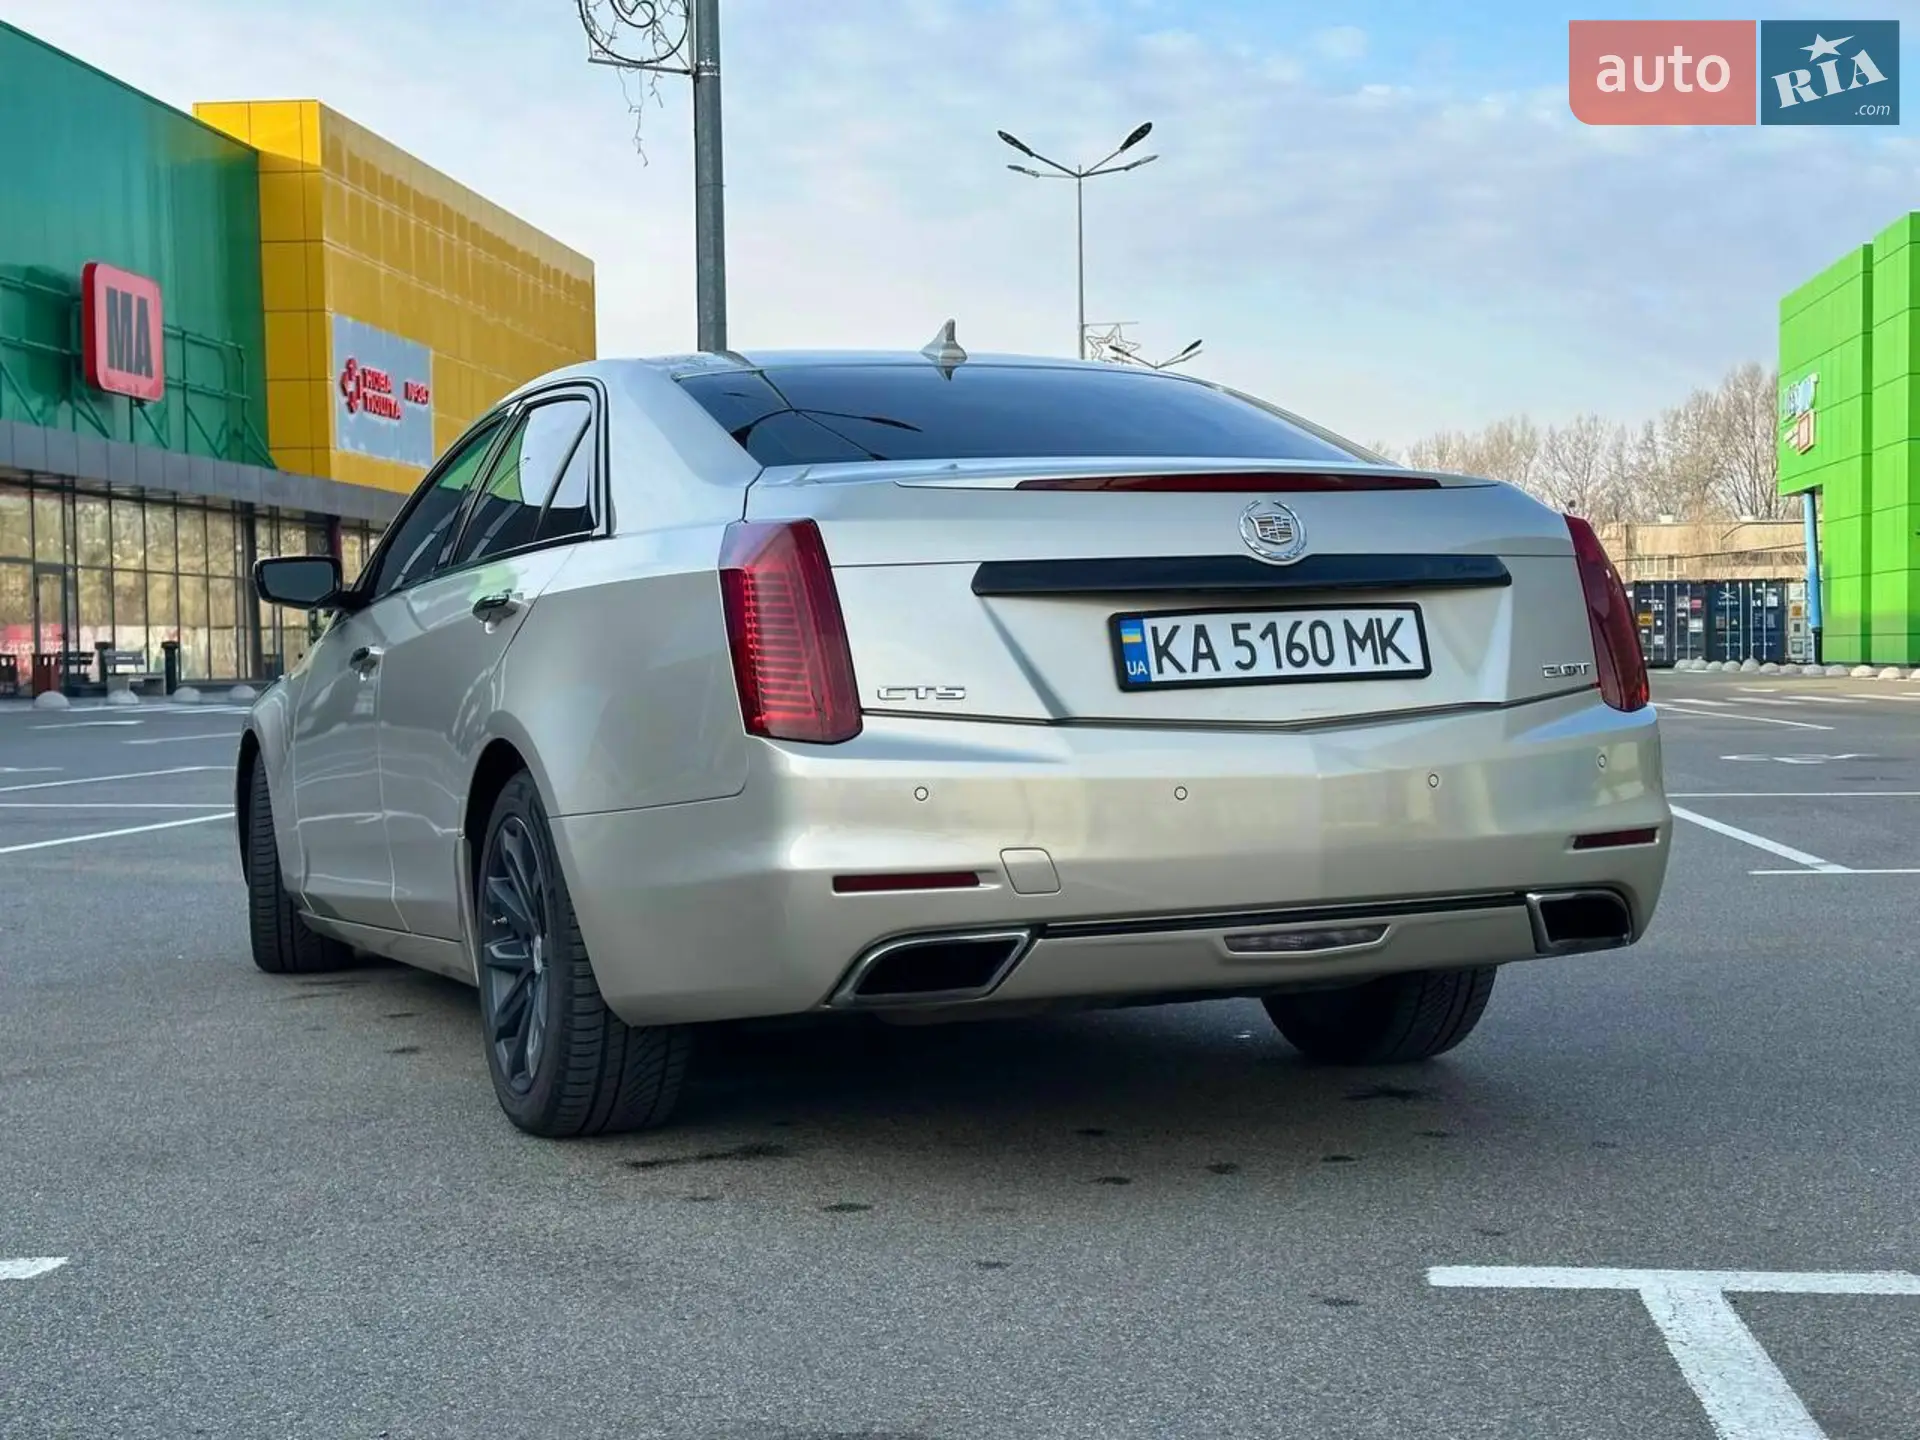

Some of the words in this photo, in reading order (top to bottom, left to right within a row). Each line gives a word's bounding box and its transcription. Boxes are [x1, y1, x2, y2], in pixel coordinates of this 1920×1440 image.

[1151, 623, 1221, 675] KA
[1230, 618, 1336, 671] 5160
[1343, 616, 1412, 667] MK
[1127, 659, 1148, 676] UA
[877, 685, 966, 701] CTS
